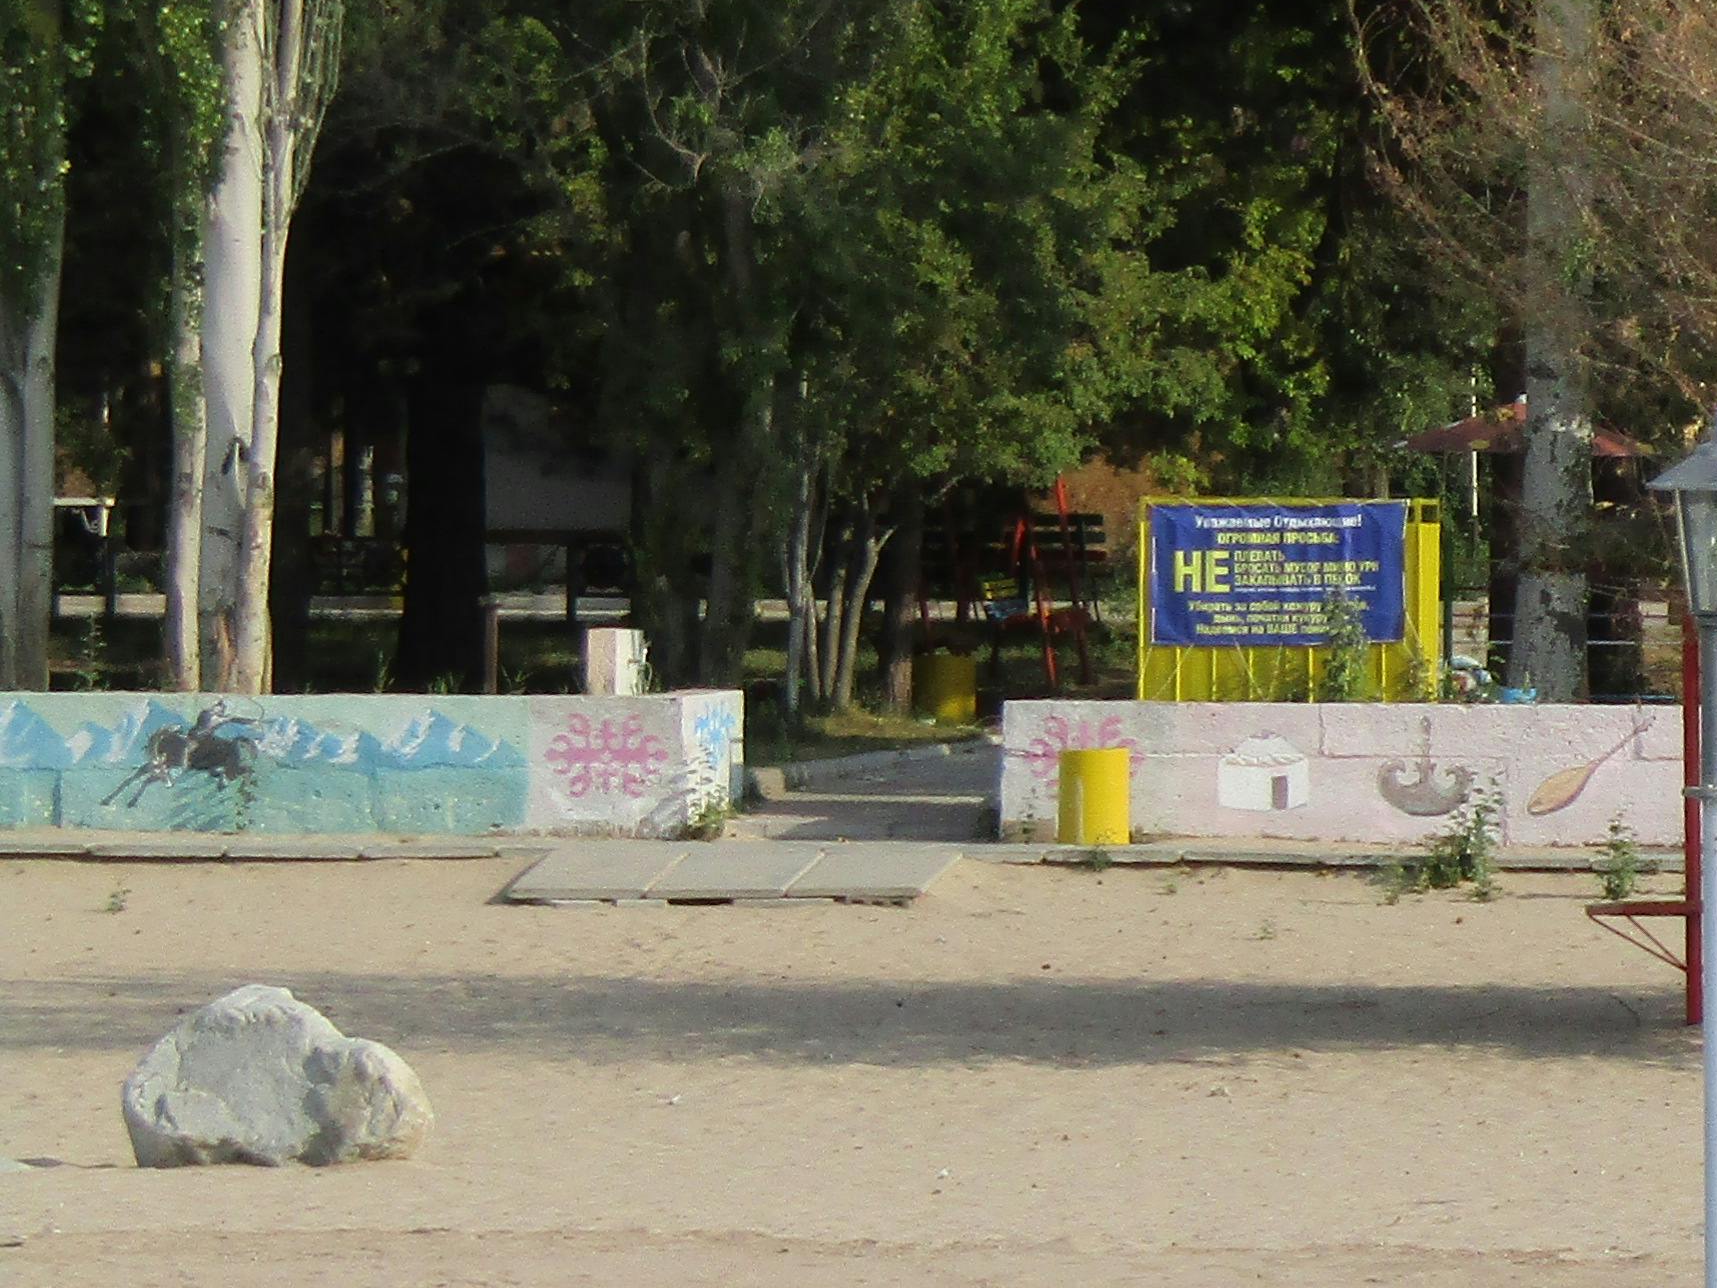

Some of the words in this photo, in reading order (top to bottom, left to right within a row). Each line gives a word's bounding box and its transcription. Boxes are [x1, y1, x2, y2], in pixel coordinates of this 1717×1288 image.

[1217, 532, 1281, 544] ОГРОМНАЯ
[1234, 550, 1285, 562] ПЛЕВАТЬ
[1174, 550, 1231, 593] НЕ
[1234, 562, 1282, 573] БРОСАТЬ
[1284, 562, 1320, 573] МУСОР
[1322, 561, 1357, 573] МИМО
[1234, 574, 1312, 585] ЗАКАПЫВАТЬ
[1313, 574, 1321, 585] В
[1323, 573, 1361, 585] ПЕСОК
